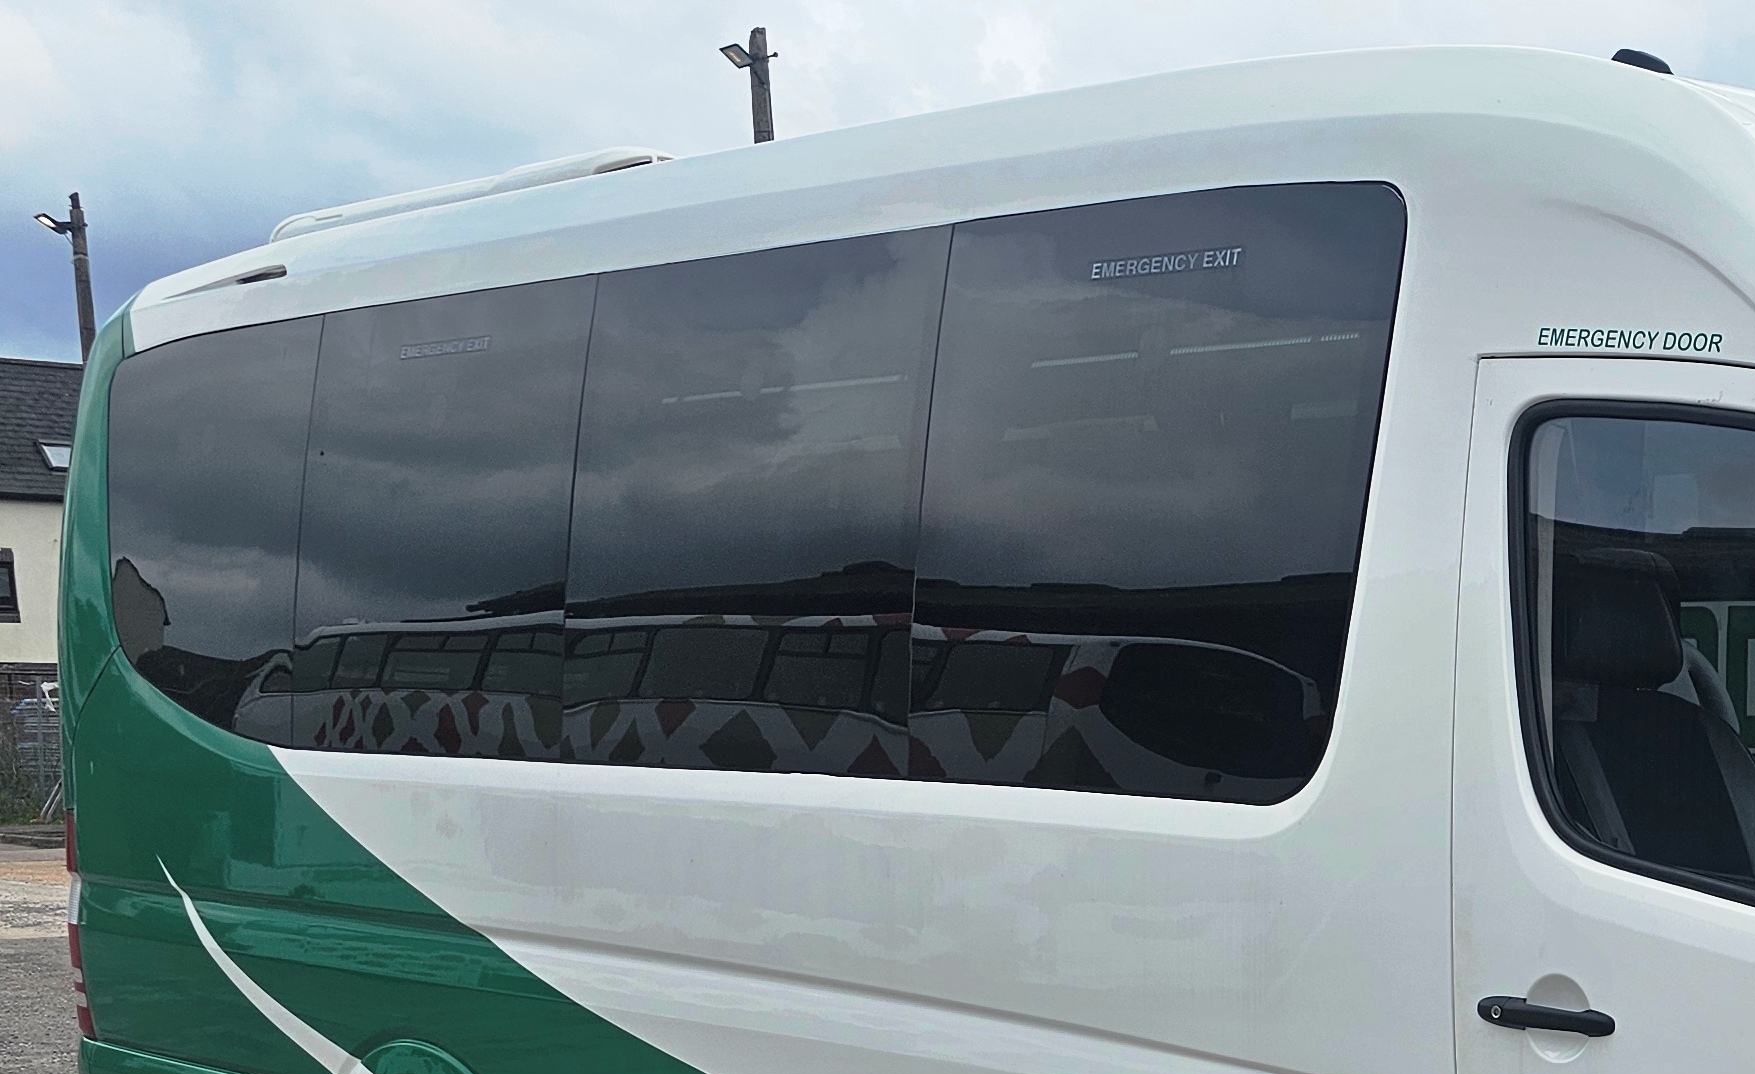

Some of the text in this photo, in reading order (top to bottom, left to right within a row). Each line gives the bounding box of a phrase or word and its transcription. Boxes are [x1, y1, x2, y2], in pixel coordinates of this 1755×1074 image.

[1091, 248, 1242, 280] EMERGENCY EXIT
[1538, 327, 1724, 353] EMERGENCY DOOR
